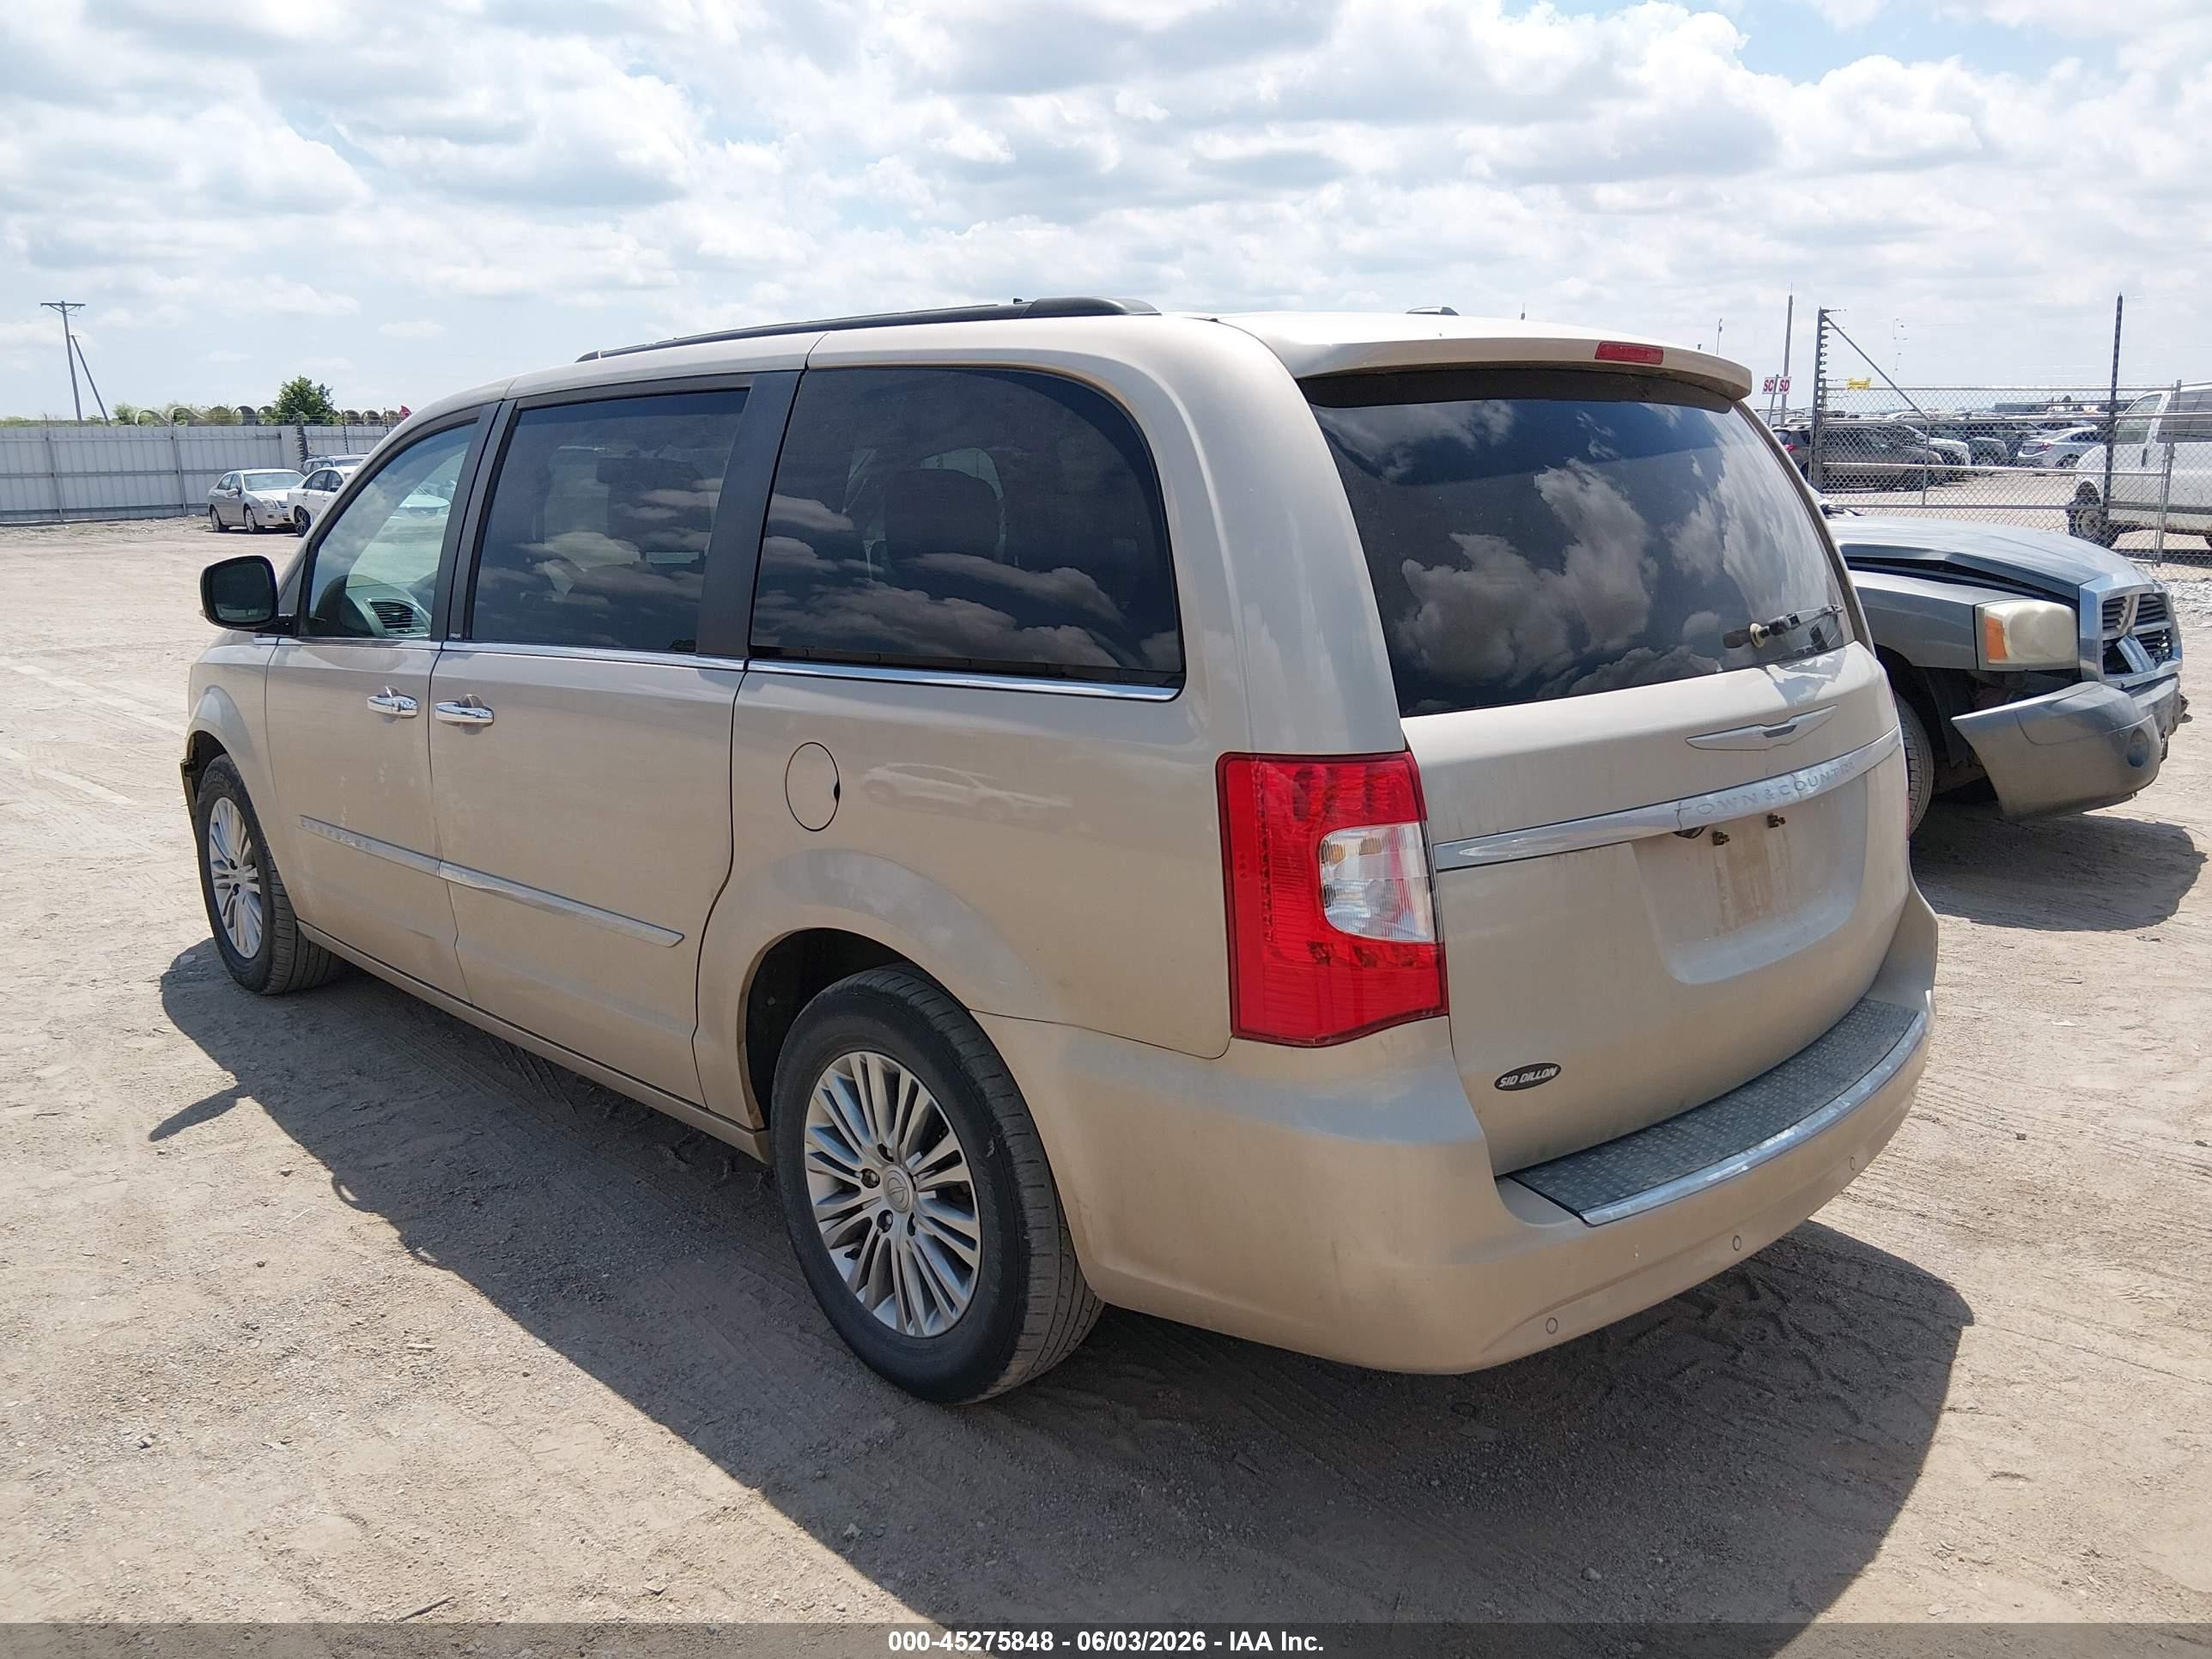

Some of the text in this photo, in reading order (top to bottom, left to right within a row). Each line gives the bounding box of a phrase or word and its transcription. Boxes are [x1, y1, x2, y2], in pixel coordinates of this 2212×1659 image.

[1763, 380, 1773, 392] SC
[1779, 380, 1790, 392] SD
[1498, 1066, 1559, 1088] SID DILLON
